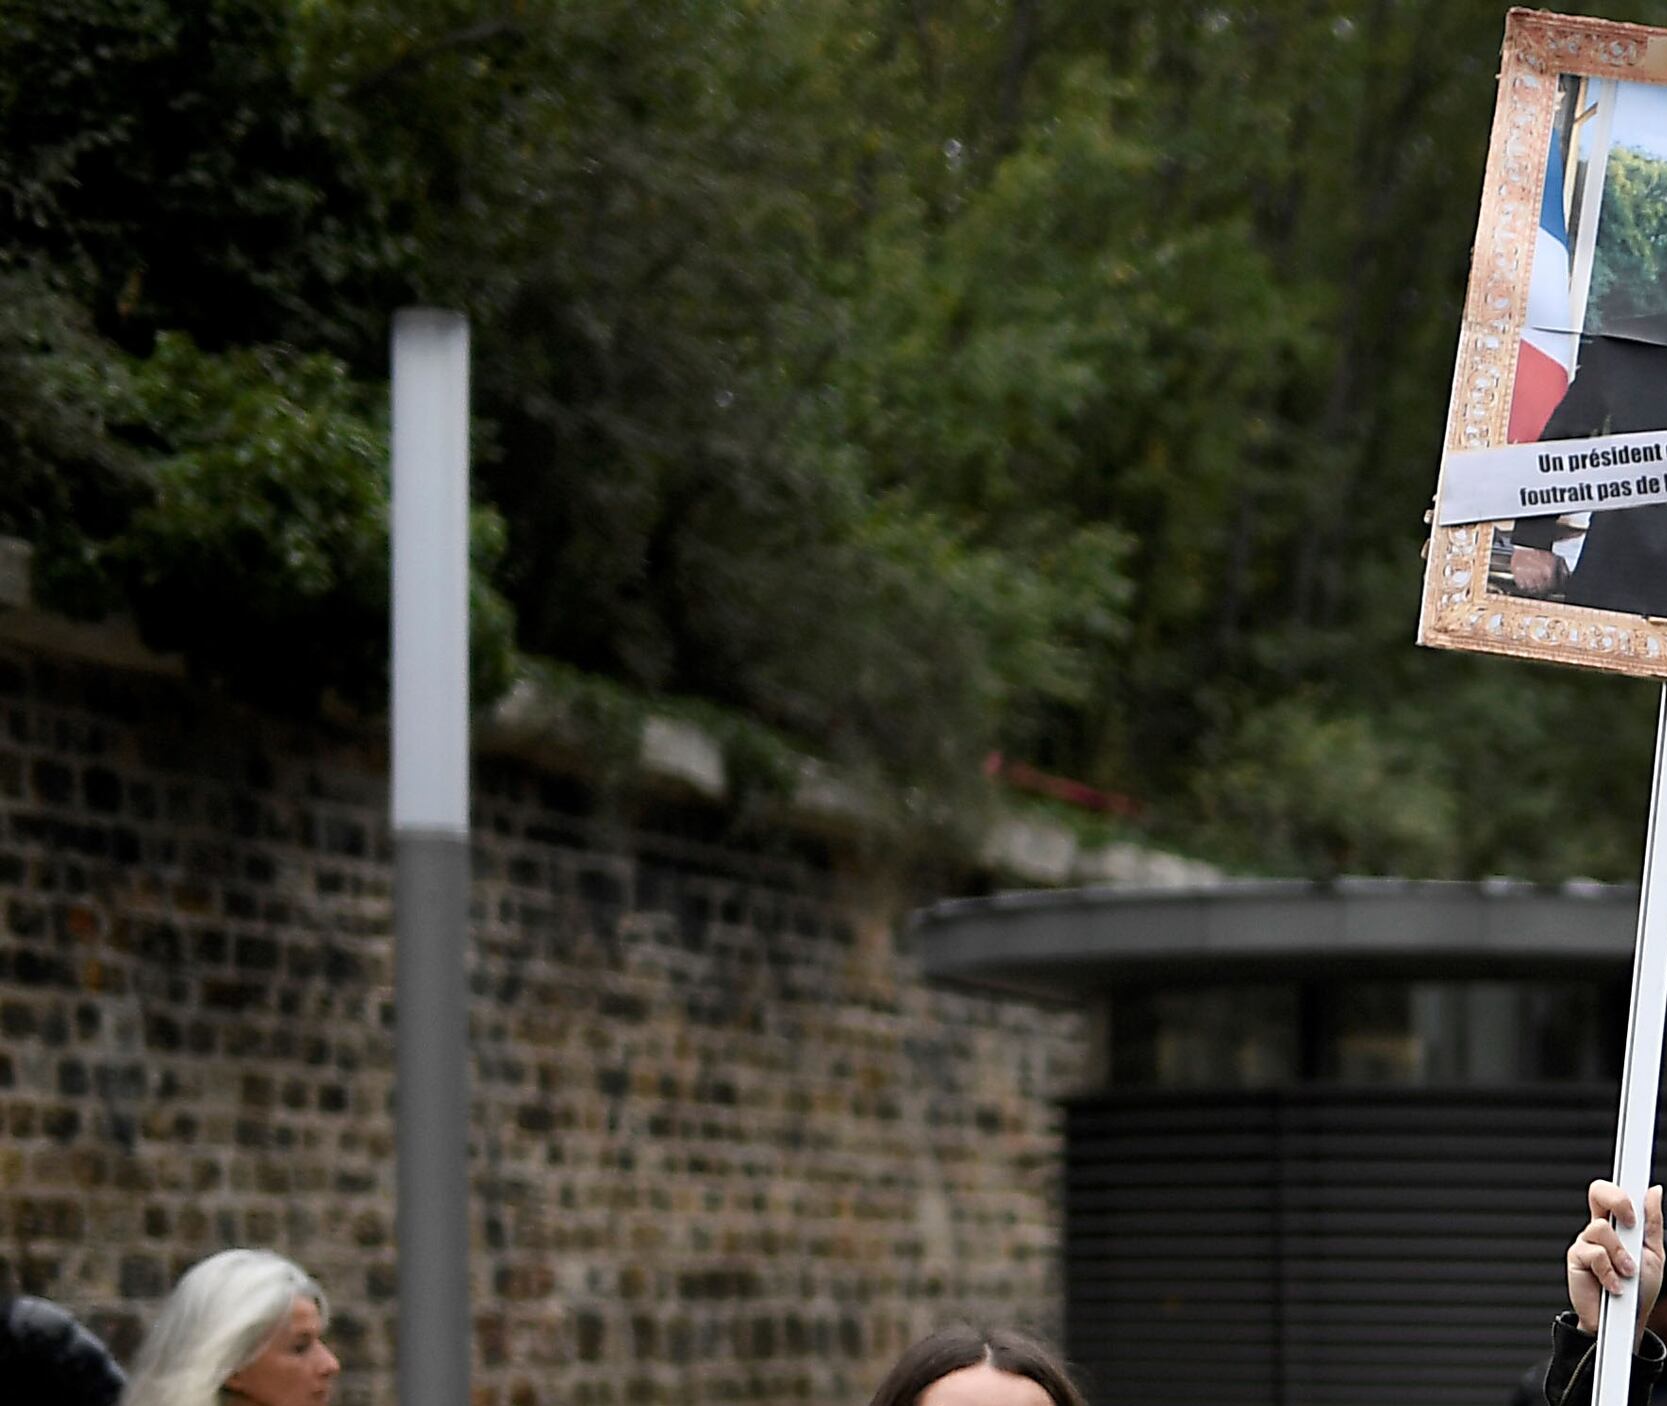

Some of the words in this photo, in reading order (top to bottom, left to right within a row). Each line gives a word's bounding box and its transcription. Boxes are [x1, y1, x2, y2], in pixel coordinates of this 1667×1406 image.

[1538, 453, 1564, 474] Un
[1568, 443, 1663, 472] président
[1520, 482, 1594, 507] foutrait
[1598, 479, 1633, 502] pas
[1637, 473, 1661, 495] de
